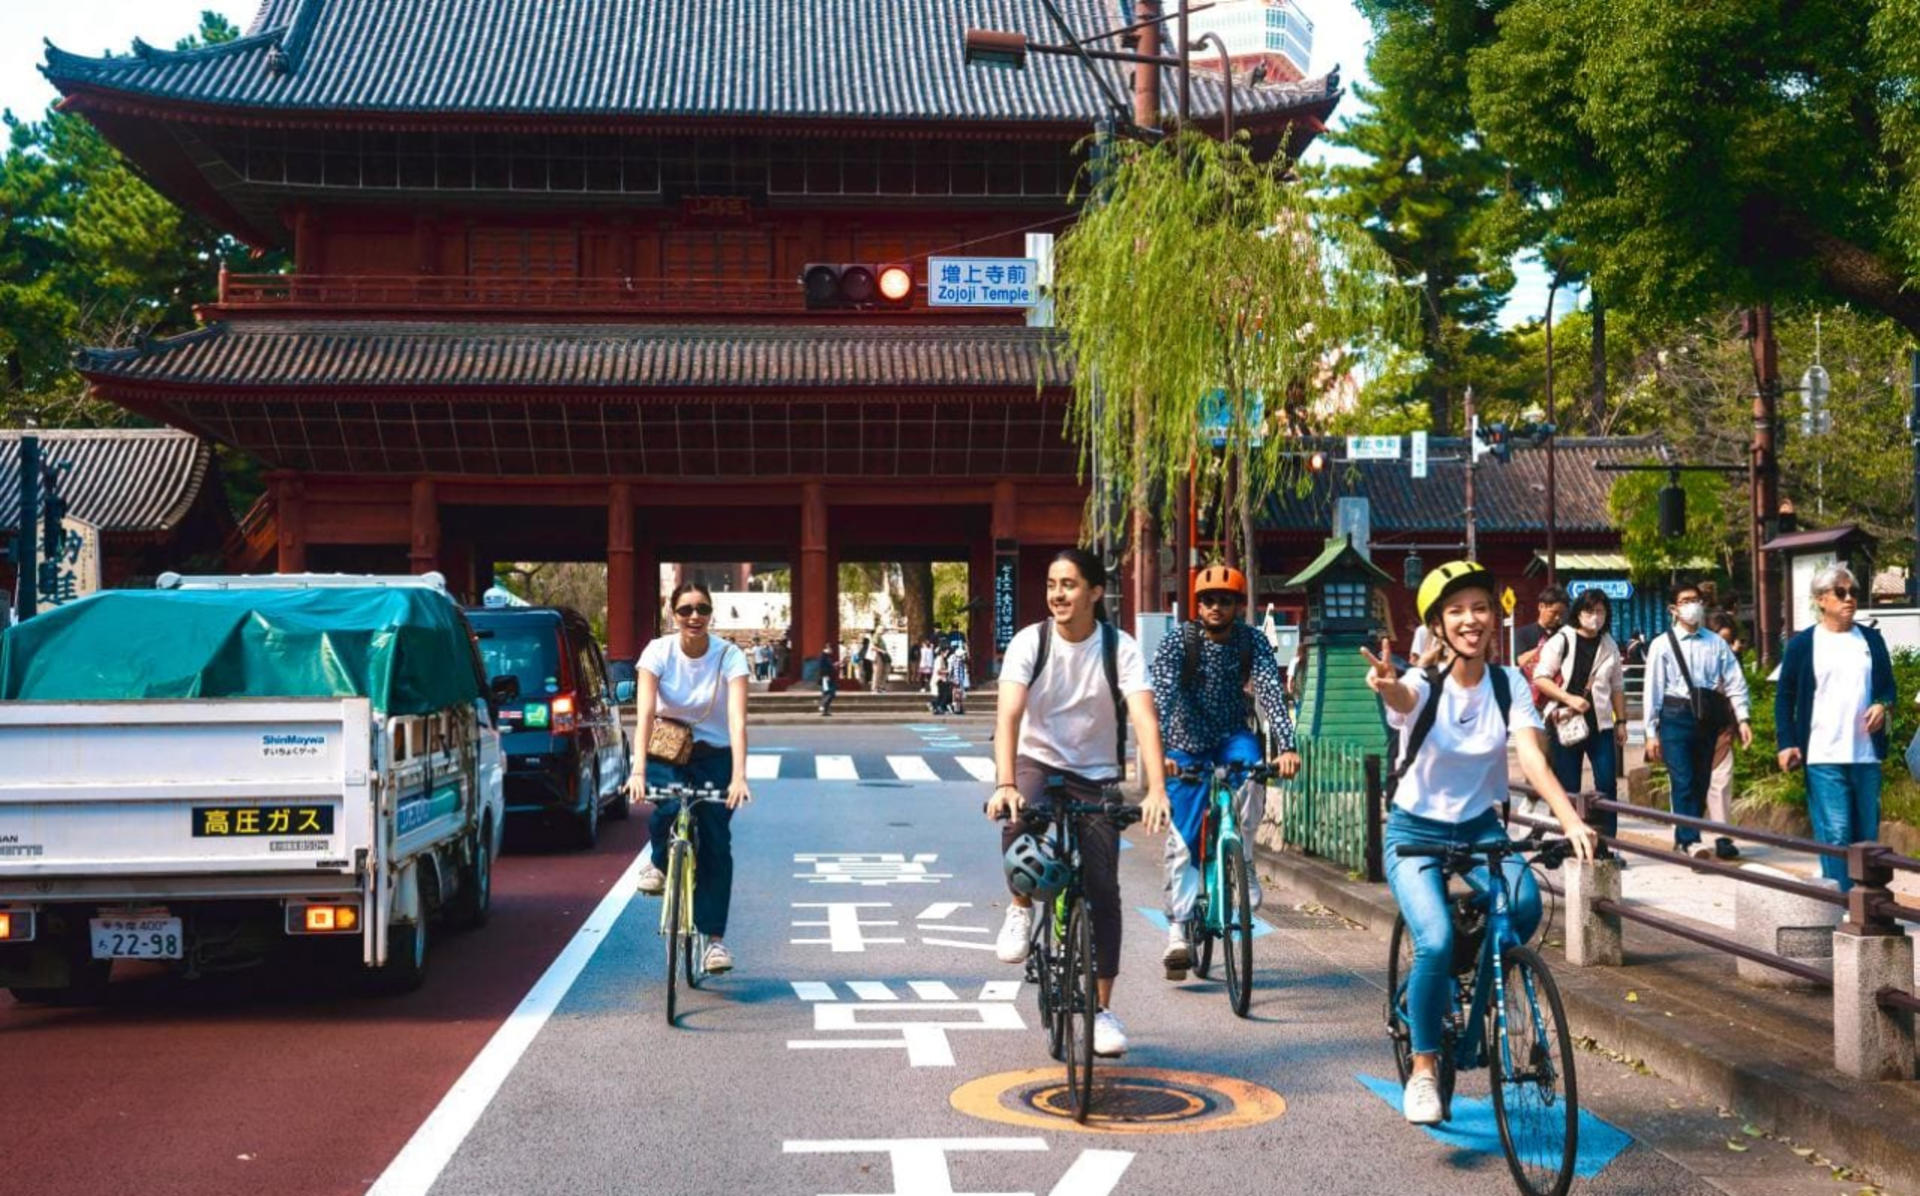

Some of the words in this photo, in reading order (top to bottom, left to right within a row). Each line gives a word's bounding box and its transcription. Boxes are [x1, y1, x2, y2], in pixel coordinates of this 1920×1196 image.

[941, 264, 1027, 285] 増上寺前
[938, 286, 976, 302] Zojoji
[981, 286, 1029, 304] Temple
[263, 734, 325, 746] ShinMaywa
[204, 808, 321, 835] 高圧ガス
[112, 933, 178, 956] 22-98
